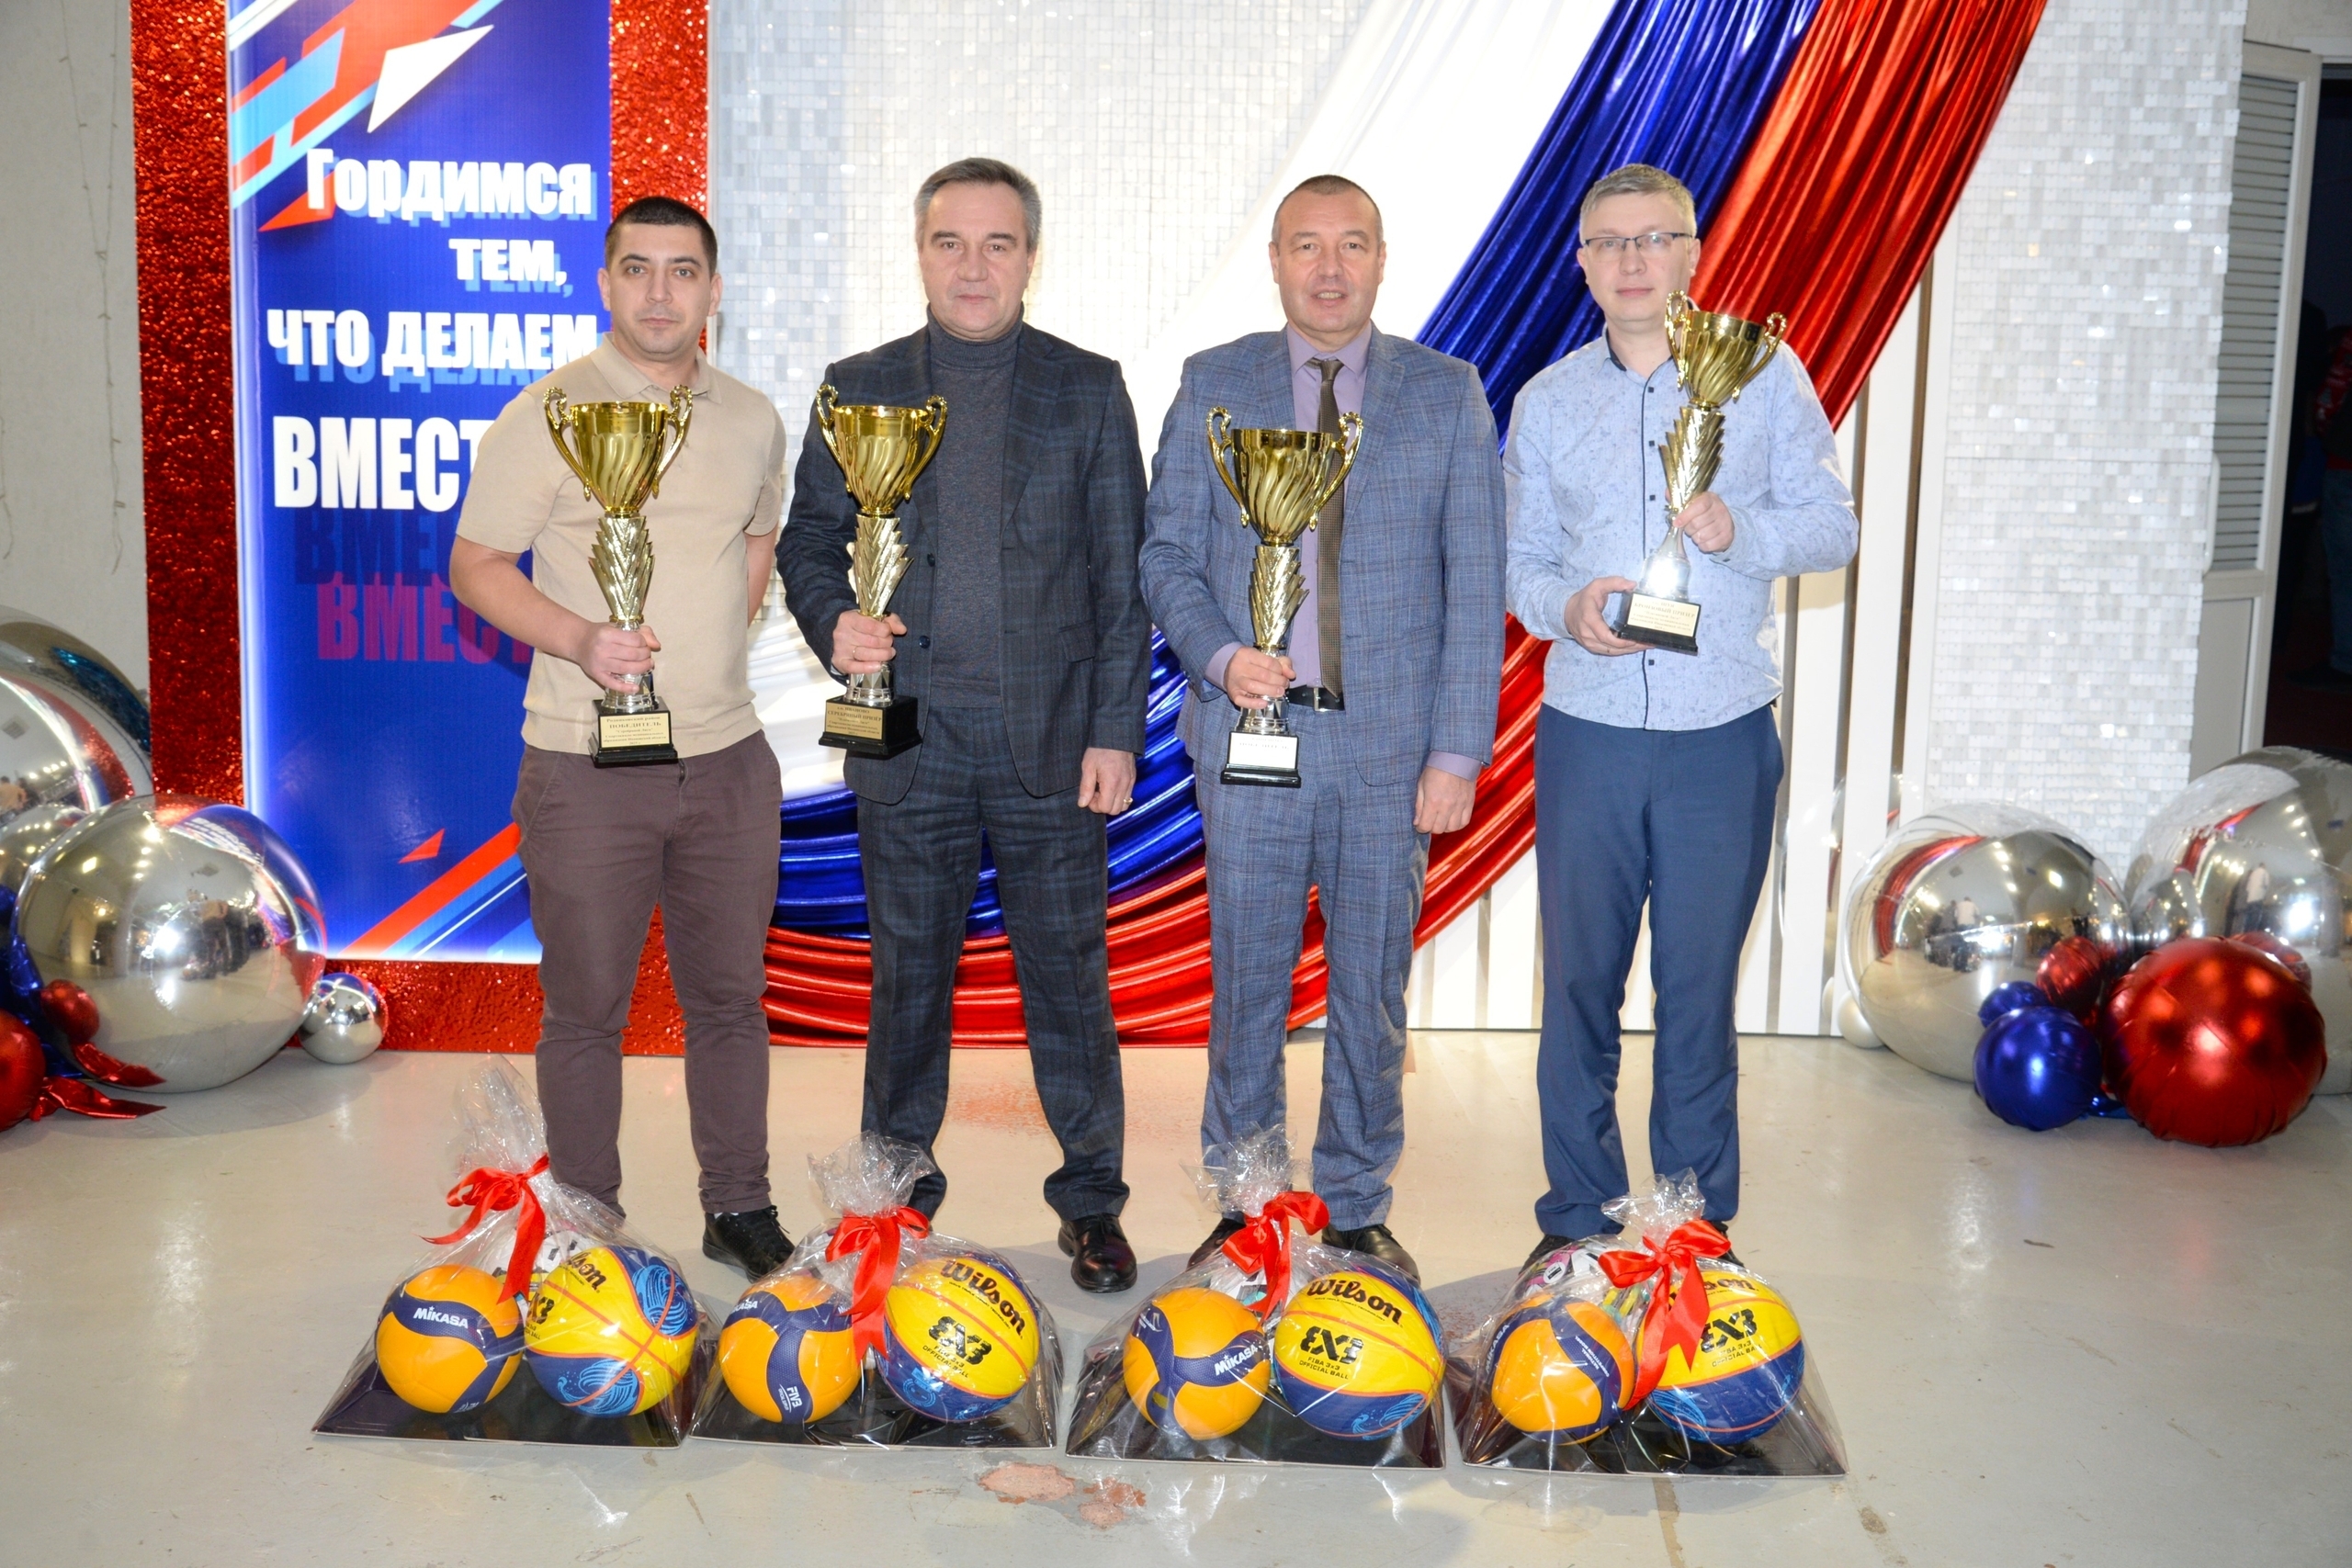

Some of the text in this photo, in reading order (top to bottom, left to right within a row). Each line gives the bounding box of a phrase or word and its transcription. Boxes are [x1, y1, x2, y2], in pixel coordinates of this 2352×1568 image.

[307, 148, 592, 221] Гордимся
[267, 310, 597, 377] ЧТО ДЕЛАЕМ
[273, 415, 498, 513] ВМЕСТ
[567, 1252, 606, 1291] lson
[413, 1306, 468, 1329] MIKASA
[941, 1260, 1025, 1336] Wilson
[1306, 1280, 1402, 1325] Wilson
[1214, 1344, 1258, 1376] MIKASA
[1299, 1360, 1349, 1380] OFFICIAL BALL
[1308, 1356, 1324, 1366] FIBA
